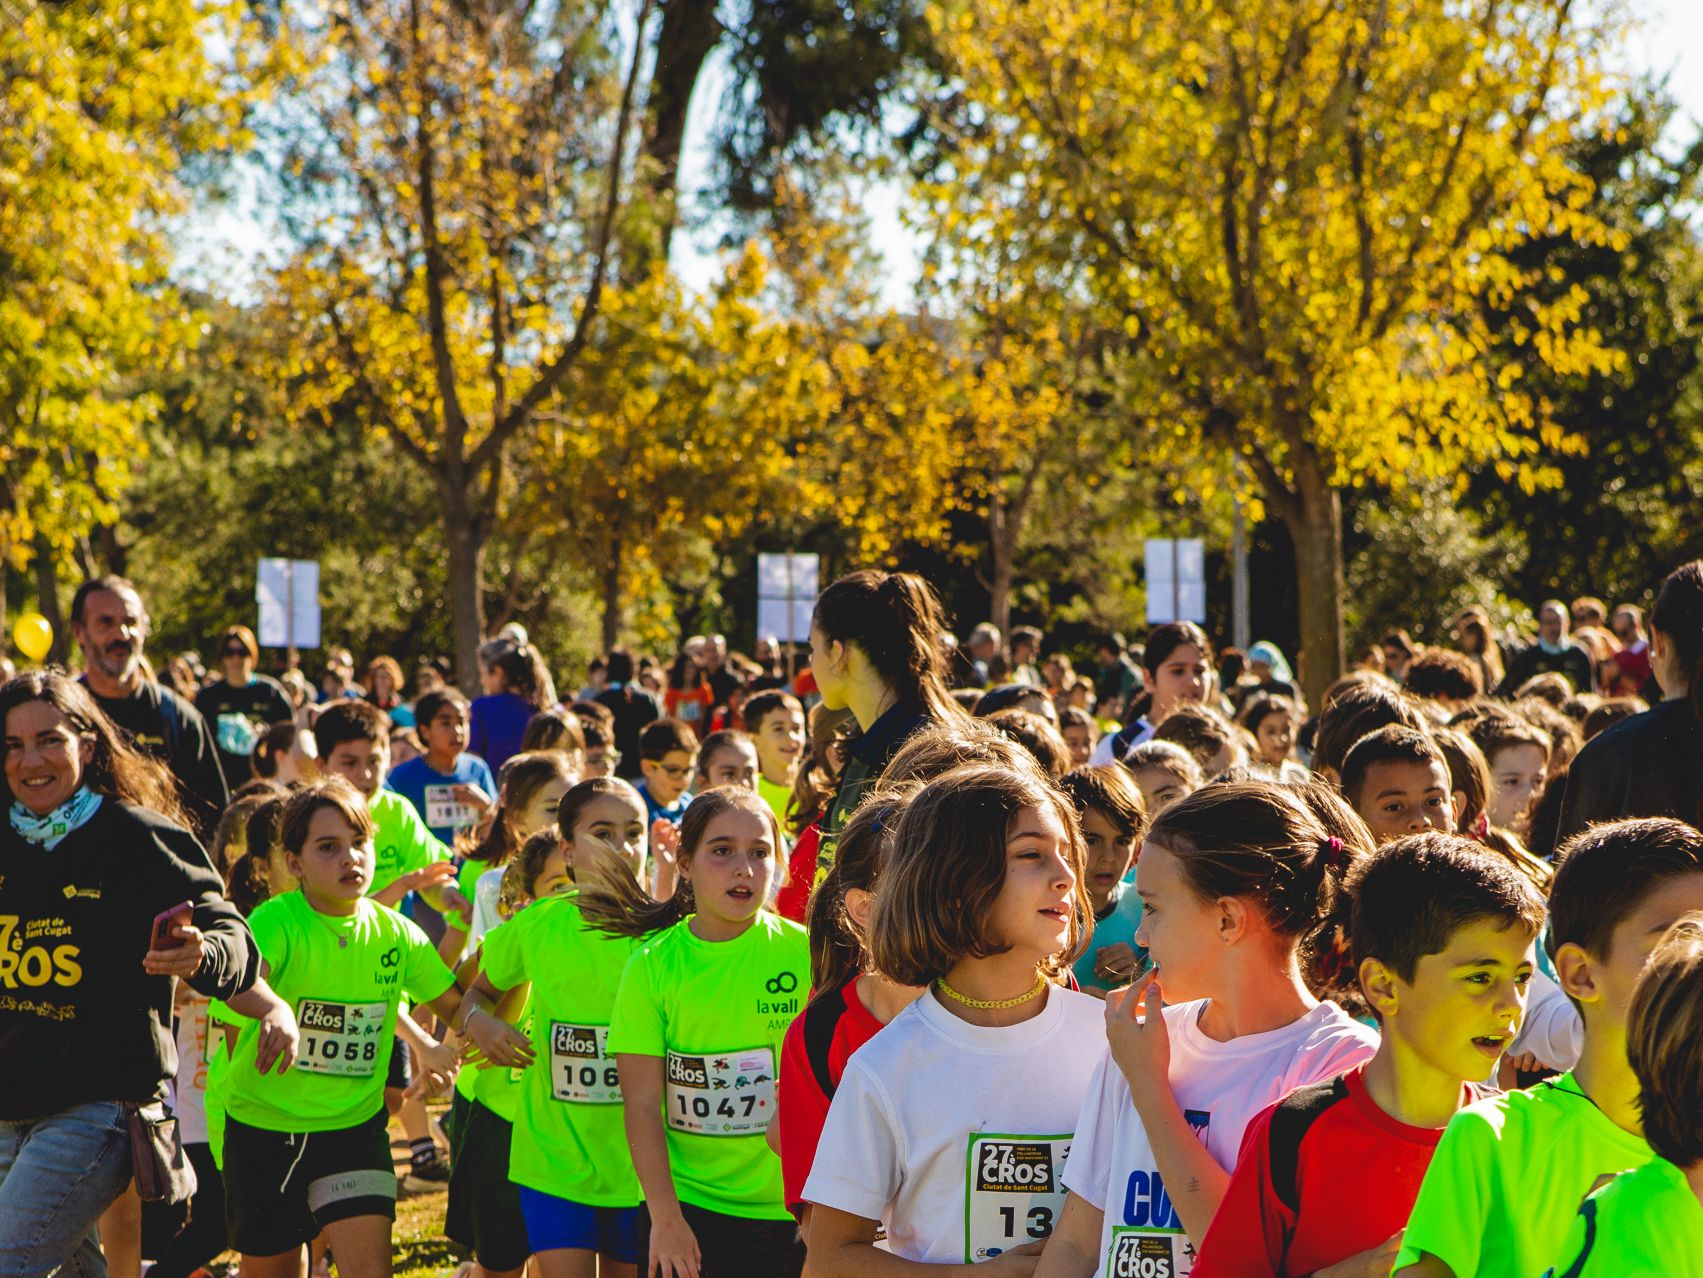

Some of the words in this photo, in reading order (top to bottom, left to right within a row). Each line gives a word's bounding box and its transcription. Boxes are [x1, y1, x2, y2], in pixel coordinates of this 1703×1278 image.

[26, 919, 50, 930] Ciutat
[52, 917, 64, 927] de
[45, 926, 72, 937] Cugat
[0, 944, 82, 988] ROS
[757, 999, 769, 1014] la
[772, 999, 798, 1014] vall
[304, 1013, 343, 1028] CROS
[767, 1019, 790, 1031] AMP
[307, 1037, 376, 1061] 1058
[557, 1039, 595, 1054] CROS
[564, 1064, 620, 1087] 106
[669, 1066, 705, 1083] CROS
[677, 1094, 756, 1118] 1047
[982, 1163, 1049, 1183] CROS
[1000, 1206, 1053, 1239] 13
